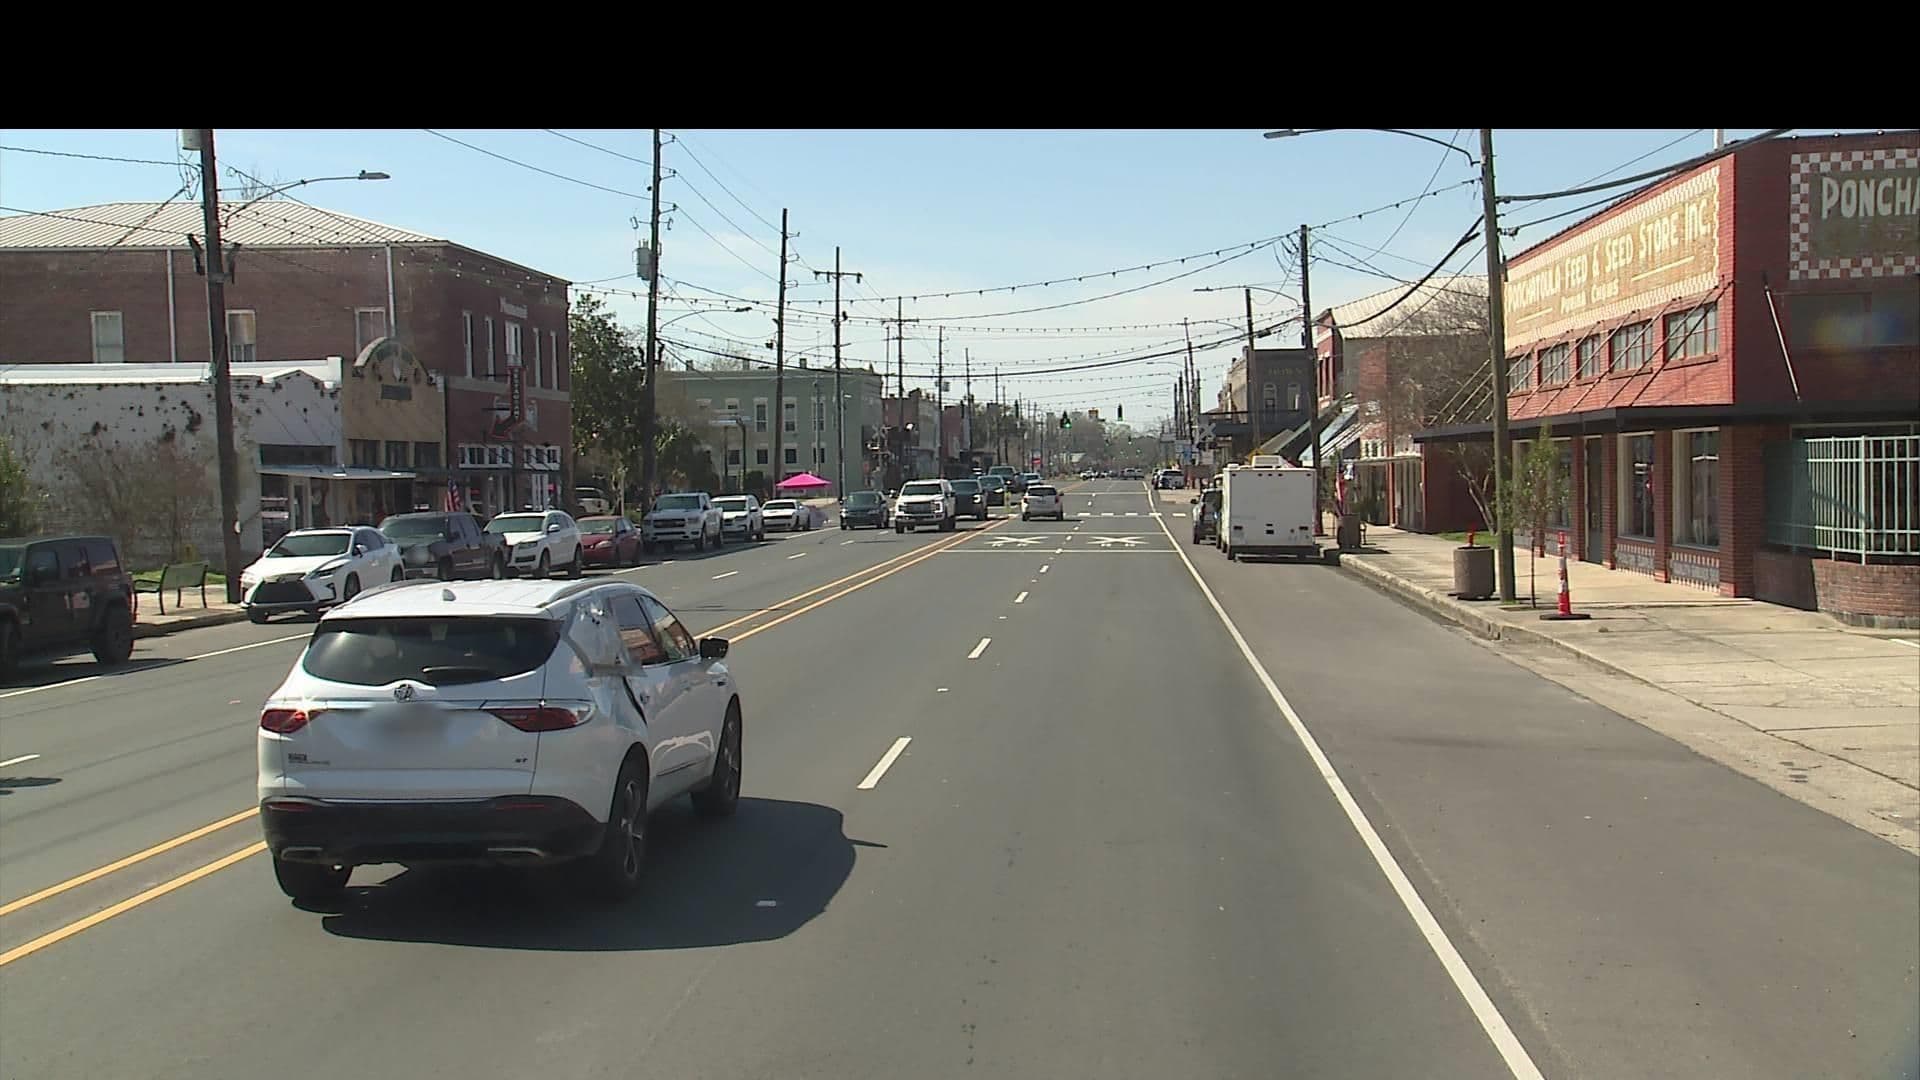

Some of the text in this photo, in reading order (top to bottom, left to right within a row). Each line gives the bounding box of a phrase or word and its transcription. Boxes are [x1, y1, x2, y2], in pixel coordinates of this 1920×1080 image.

[1565, 254, 1588, 290] FEED
[1592, 243, 1600, 278] &
[1605, 233, 1633, 273] SEED
[1639, 211, 1679, 259] STORE
